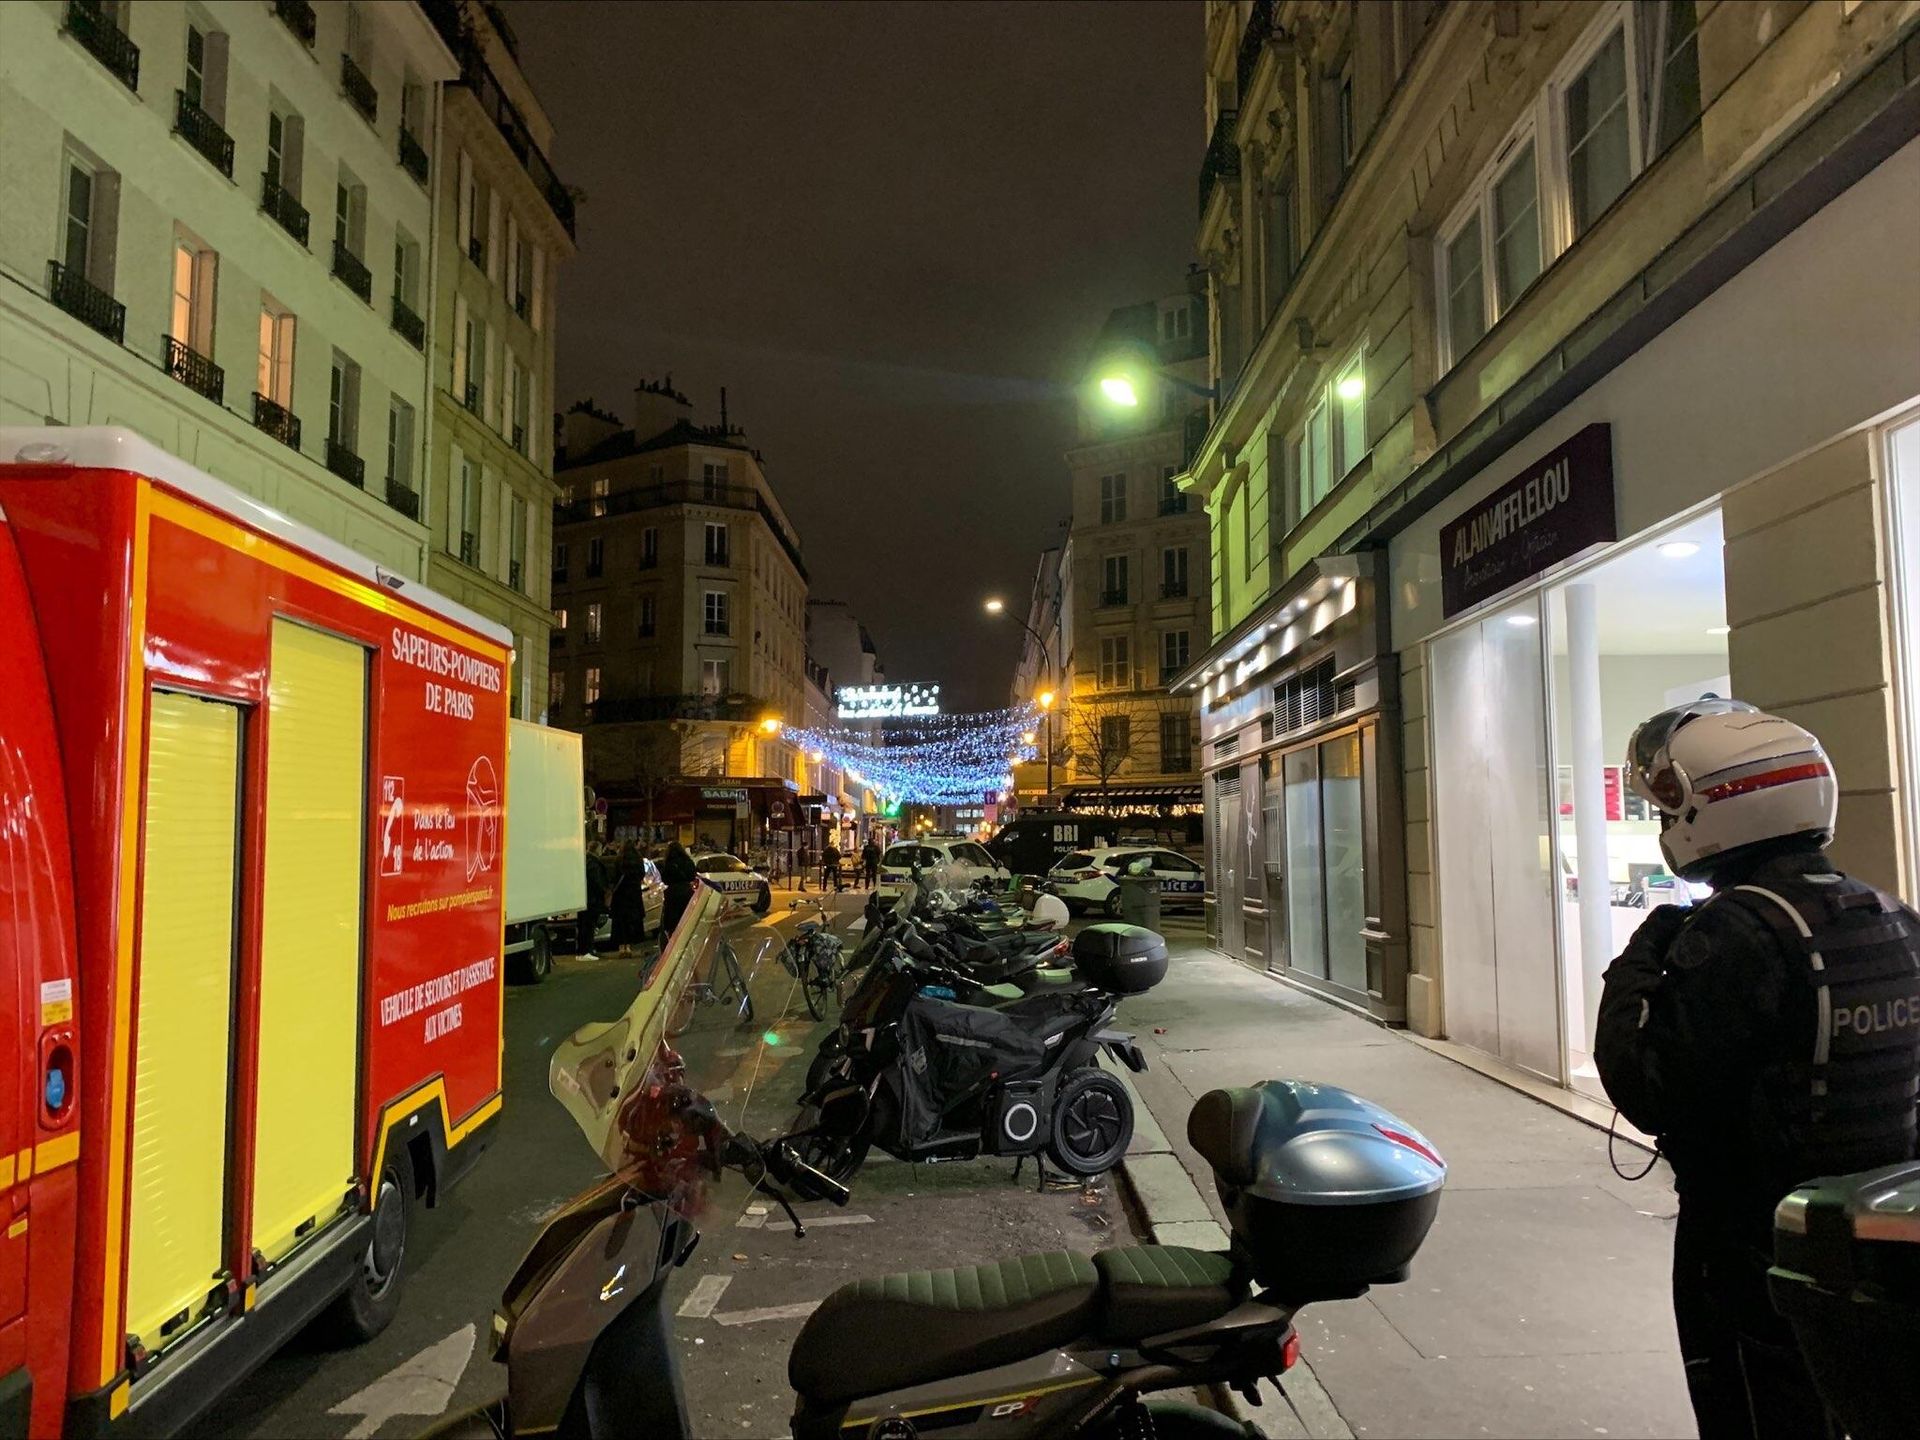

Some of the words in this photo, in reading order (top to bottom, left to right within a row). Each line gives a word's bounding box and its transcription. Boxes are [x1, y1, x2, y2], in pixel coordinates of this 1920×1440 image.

[392, 628, 500, 693] SAPEURS-POMPIERS
[425, 682, 442, 712] DE
[444, 688, 474, 720] PARIS
[384, 780, 395, 802] 112
[444, 808, 456, 830] feu
[1053, 824, 1078, 842] BRI
[413, 838, 423, 861] de
[425, 837, 455, 861] l'action
[724, 881, 750, 890] POLICE
[1160, 880, 1187, 891] LICE
[387, 904, 406, 922] Nous
[406, 898, 439, 918] recrutons
[439, 897, 449, 911] sur
[452, 970, 461, 996] ET
[1832, 996, 1920, 1037] POLICE
